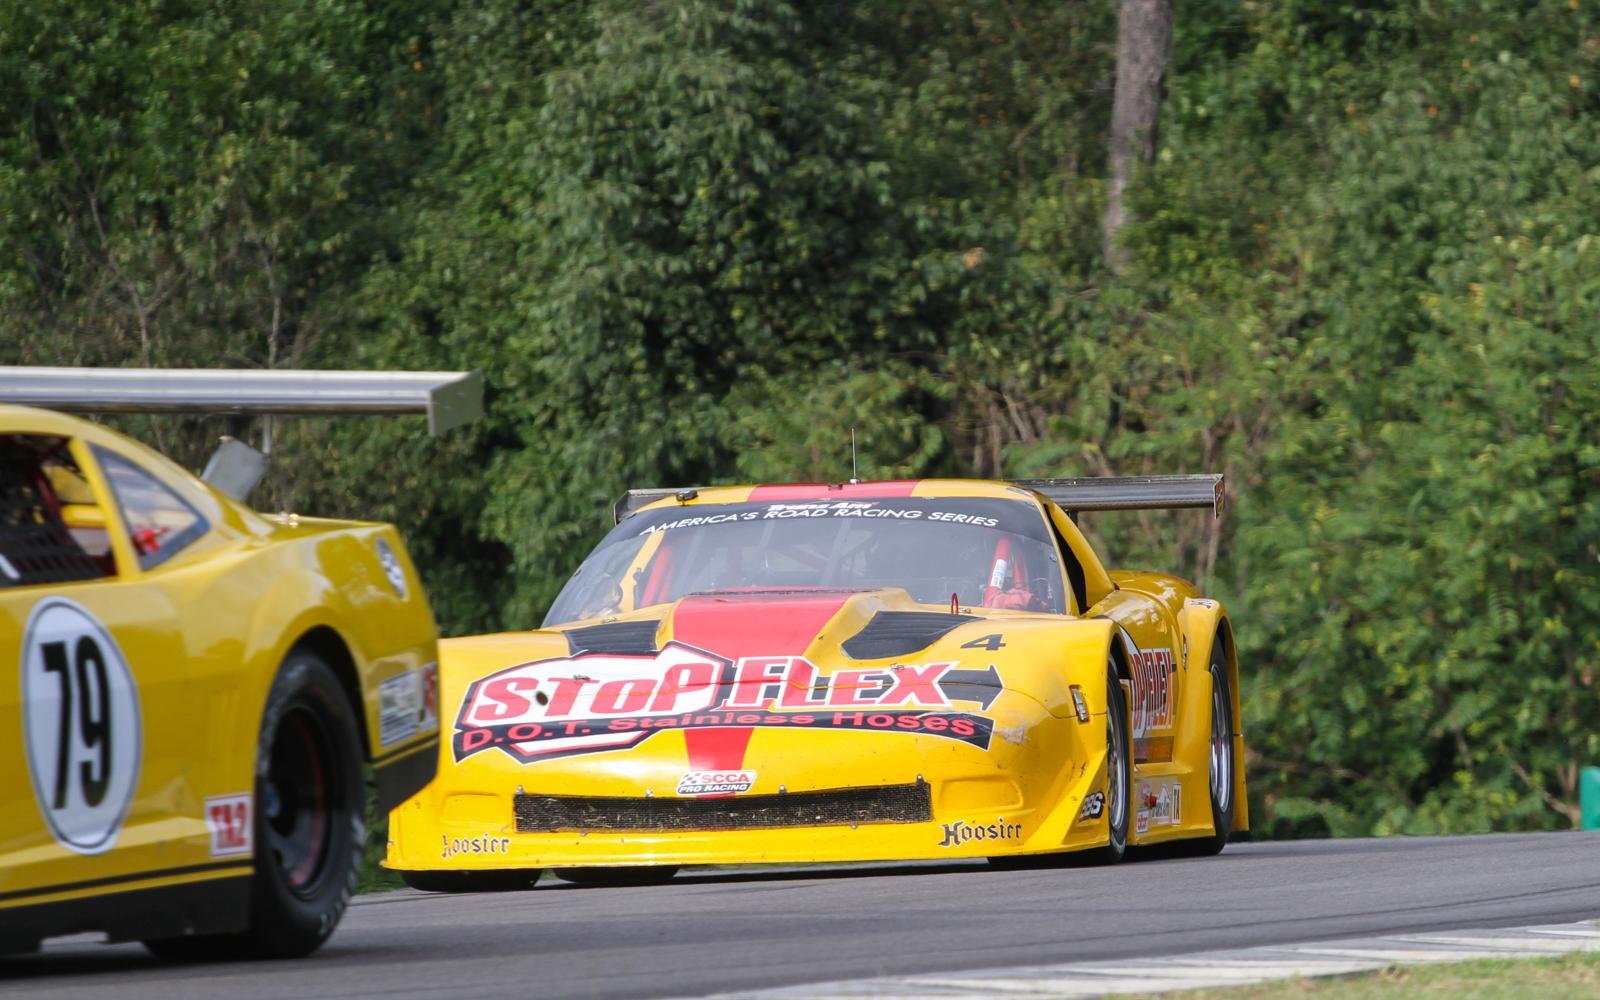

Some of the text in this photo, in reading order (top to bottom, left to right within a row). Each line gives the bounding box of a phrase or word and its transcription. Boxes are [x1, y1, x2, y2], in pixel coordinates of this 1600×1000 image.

[639, 508, 999, 536] AMERICA'S ROAD RACING SERIES
[960, 633, 1007, 651] 4
[39, 634, 113, 811] 79
[462, 710, 975, 751] D.O.T. Stainless Hoses
[679, 783, 748, 793] PRO RACING
[701, 773, 750, 784] SCCA
[209, 801, 247, 849] TA2
[937, 817, 1022, 846] Hoosier
